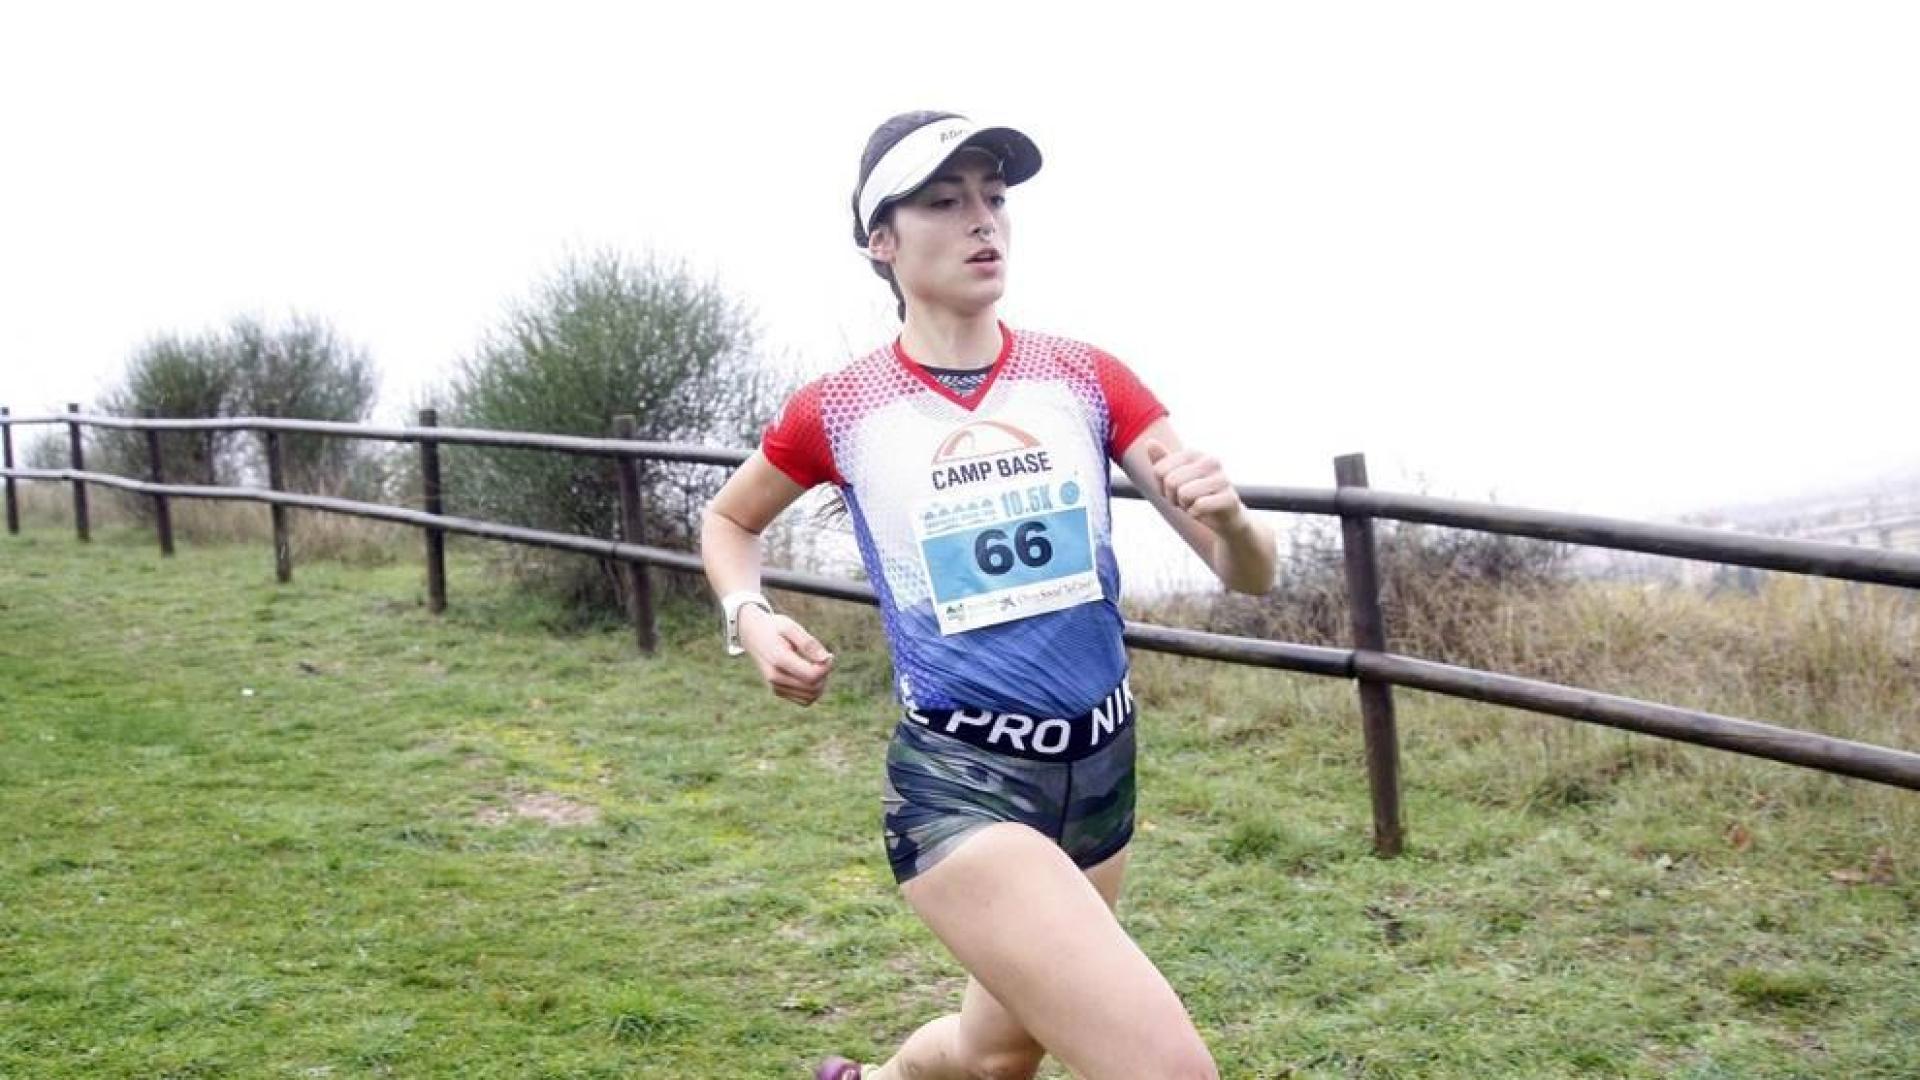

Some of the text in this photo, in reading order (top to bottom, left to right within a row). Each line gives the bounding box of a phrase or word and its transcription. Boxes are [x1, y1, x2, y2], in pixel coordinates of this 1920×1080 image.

[932, 451, 1052, 491] CAMP BASE
[975, 521, 1053, 576] 66
[945, 708, 1072, 753] PRO
